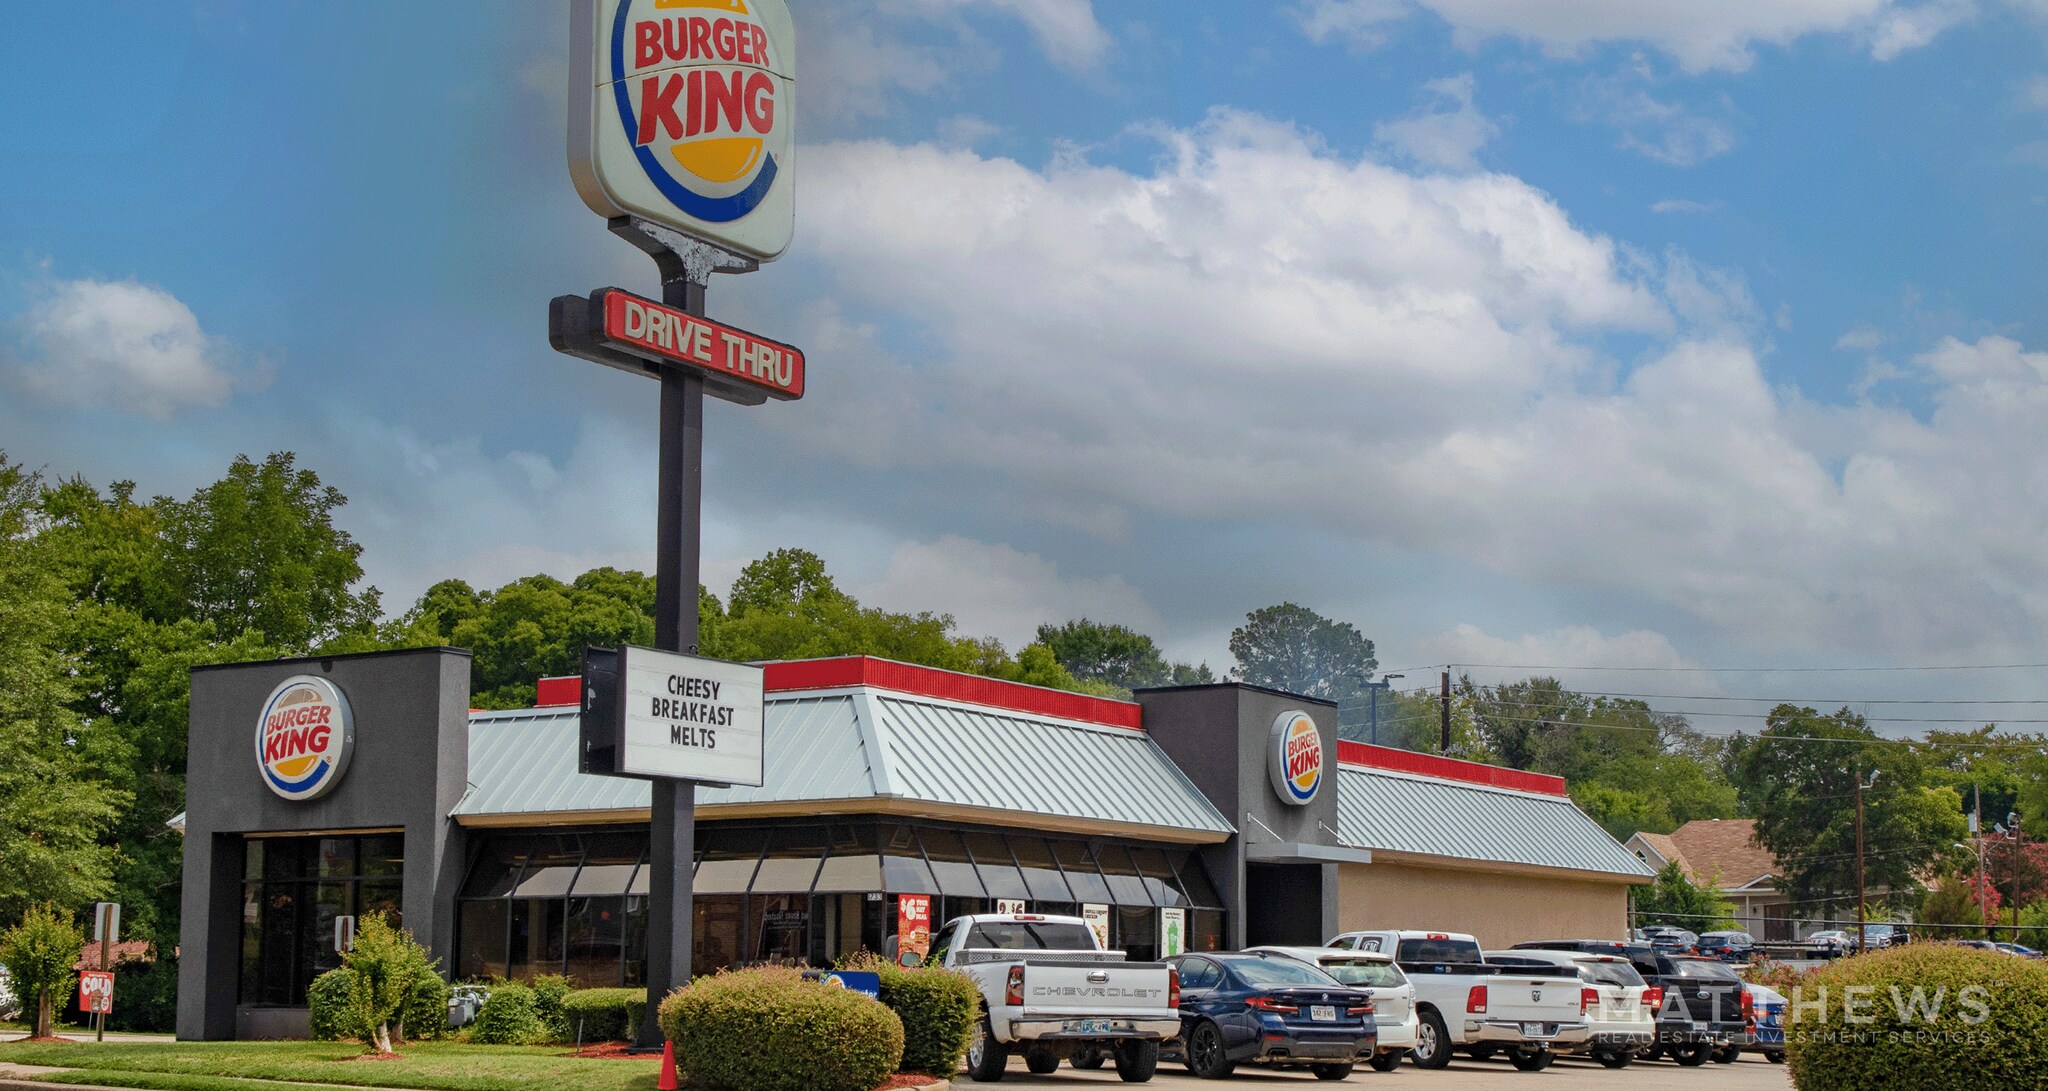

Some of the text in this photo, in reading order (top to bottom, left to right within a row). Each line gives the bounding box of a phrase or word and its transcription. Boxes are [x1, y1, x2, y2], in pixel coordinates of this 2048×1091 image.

[635, 16, 769, 69] BURGER
[637, 70, 775, 145] KING
[624, 300, 793, 387] DRIVE THRU
[667, 674, 720, 700] CHEESY
[266, 705, 331, 736] BURGER
[652, 697, 734, 726] BREAKFAST
[265, 725, 331, 764] KING
[670, 724, 716, 749] MELTS
[1287, 731, 1318, 757] BURGER
[1289, 746, 1319, 780] KING
[900, 898, 915, 920] $6
[82, 977, 111, 997] COLD
[1033, 986, 1161, 998] CHEVROLET
